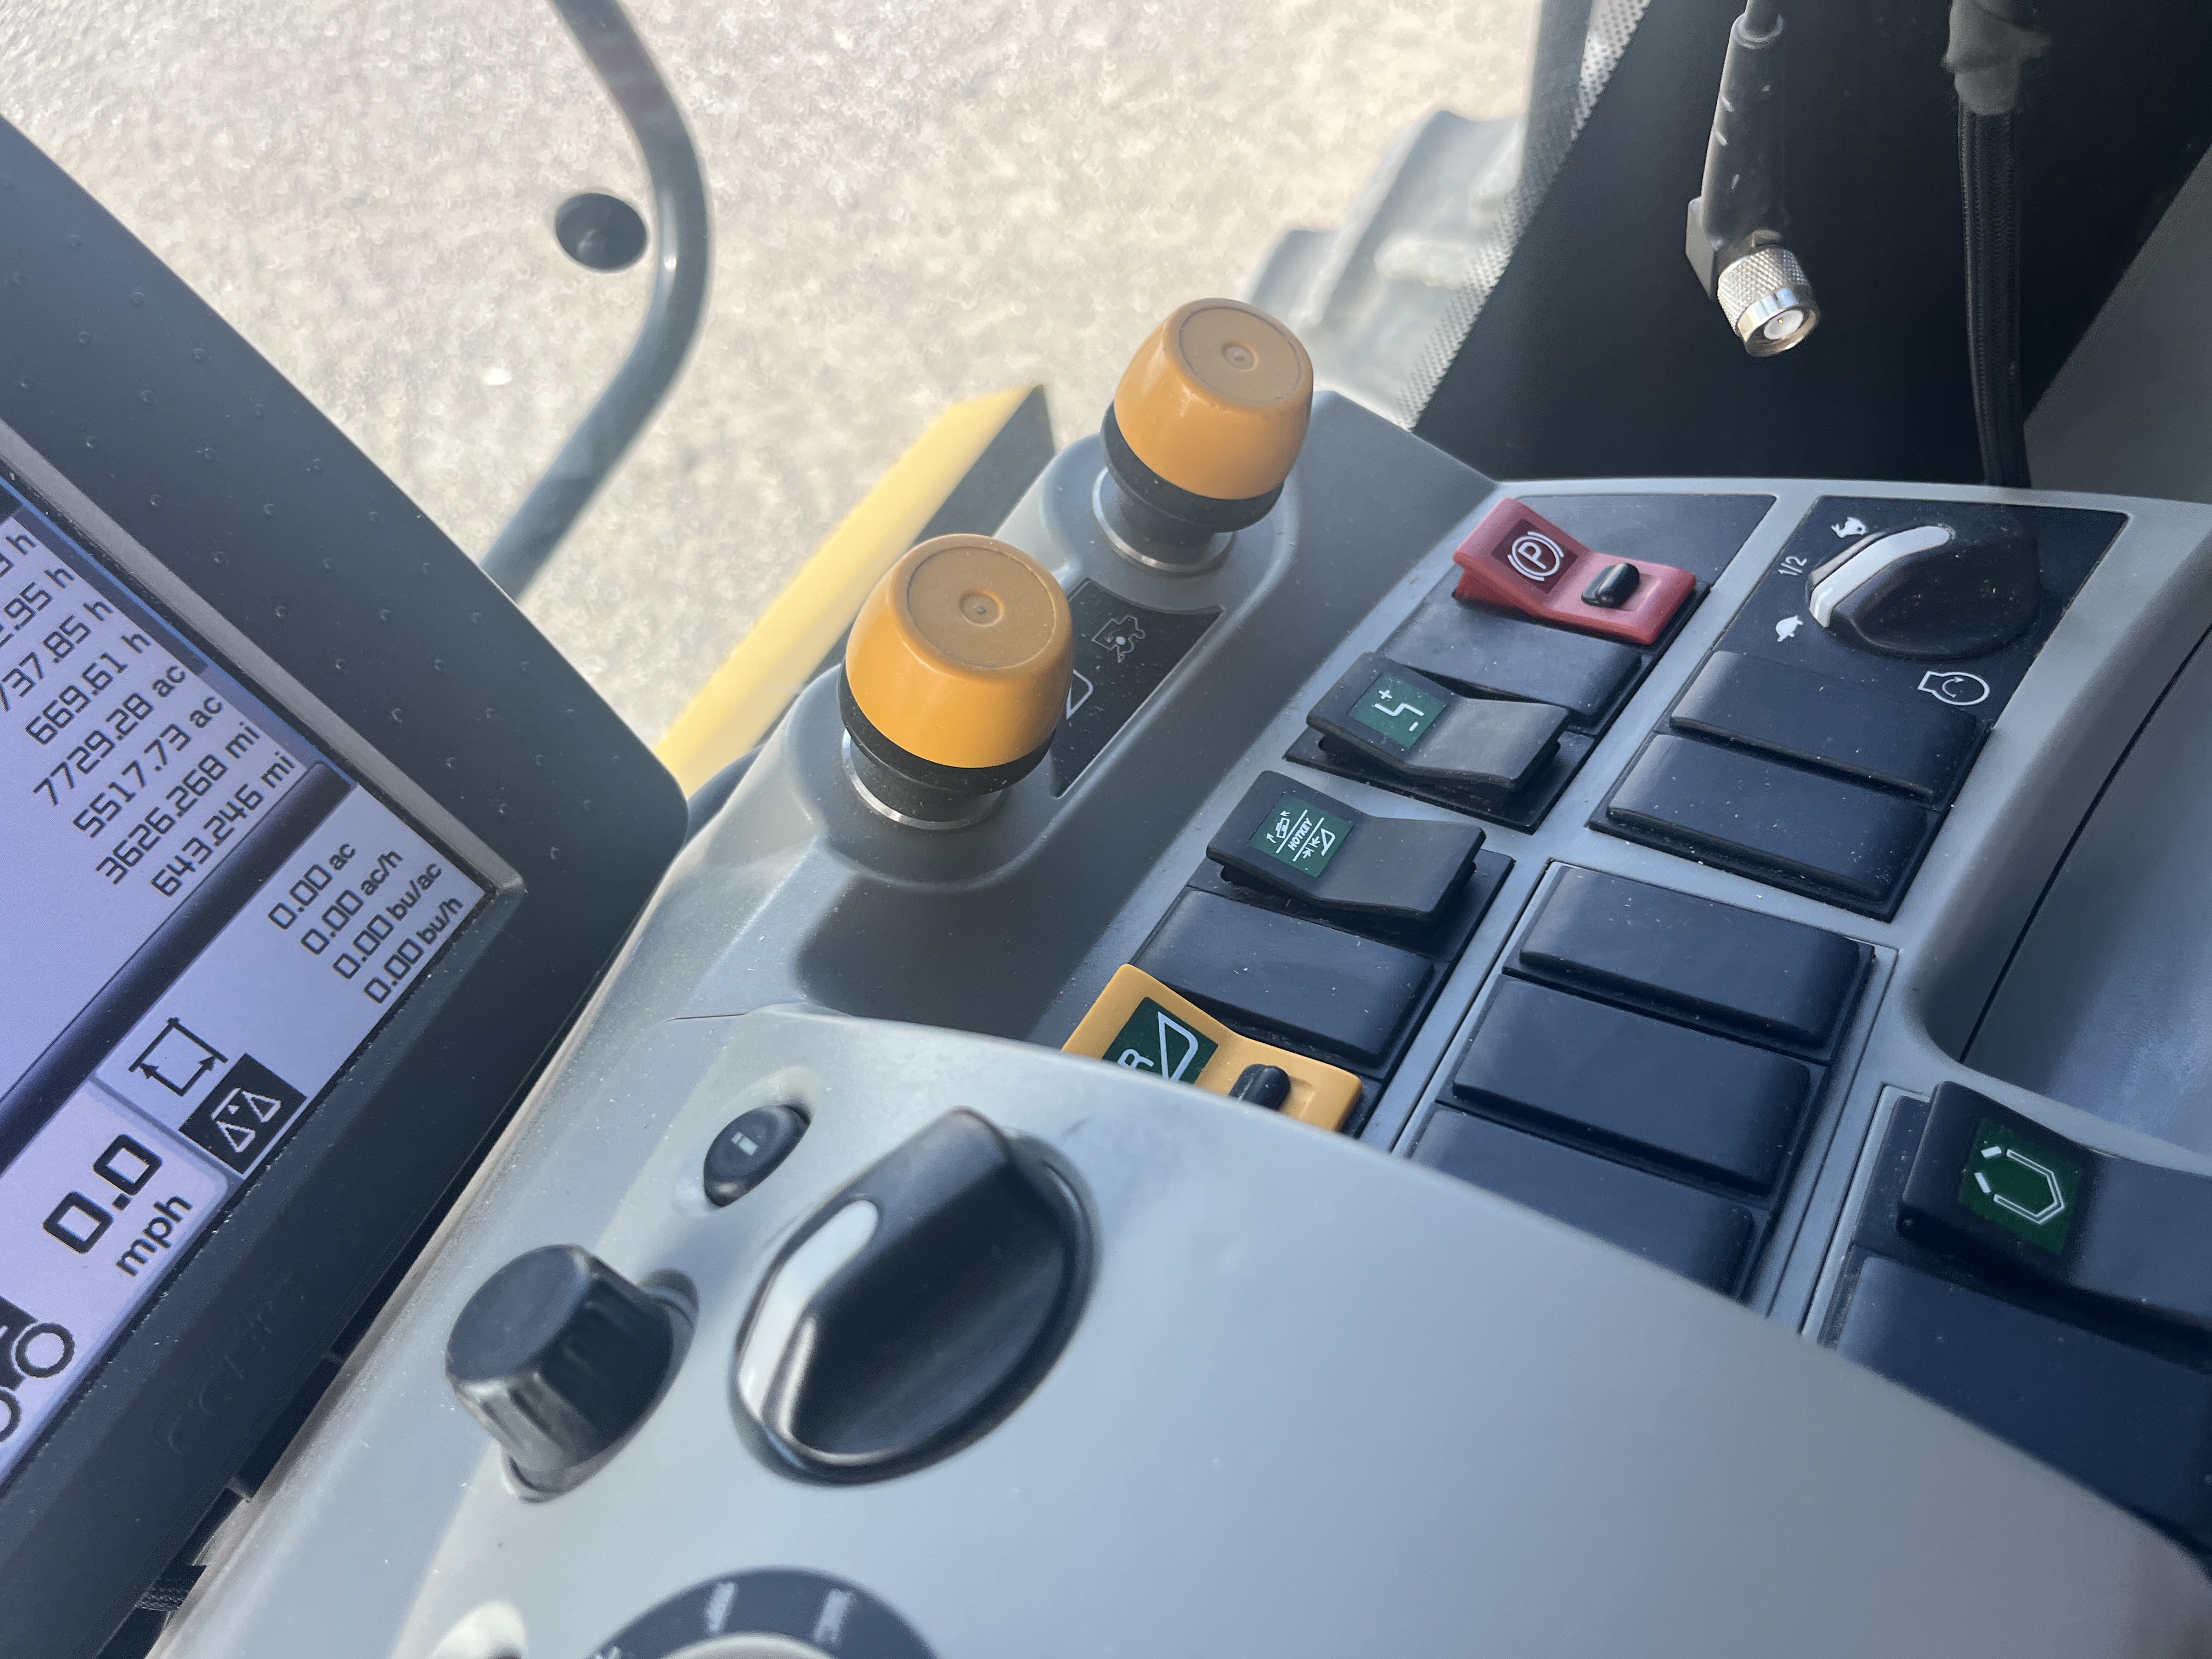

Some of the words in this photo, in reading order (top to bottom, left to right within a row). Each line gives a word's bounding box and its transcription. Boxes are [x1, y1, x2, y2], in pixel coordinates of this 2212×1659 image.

[5, 534, 36, 555] h
[1517, 541, 1547, 569] P
[1778, 556, 1808, 576] 1/2
[0, 582, 53, 647] .95
[44, 569, 75, 589] h
[83, 602, 114, 621] h
[25, 652, 128, 745] 669.61
[121, 634, 152, 653] h
[33, 693, 154, 806] 7729.28
[153, 665, 187, 697] ac
[72, 724, 192, 838] 5517.73
[189, 696, 224, 728] ac
[95, 754, 228, 885] 3626.268
[225, 721, 261, 759] mi
[151, 783, 264, 896] 643.246
[261, 751, 296, 788] mi
[1288, 817, 1312, 851] HOTKEY
[268, 864, 332, 929] 0.00
[329, 843, 356, 870] ac
[301, 890, 364, 955] 0.00
[360, 851, 403, 896] ac/h
[333, 915, 394, 979] 0.00
[386, 863, 442, 921] bu/ac
[364, 938, 424, 1003] 0.00
[416, 898, 464, 945] bu/h
[1117, 1048, 1154, 1071] R
[42, 1134, 162, 1254] 0.0
[116, 1195, 193, 1277] mph
